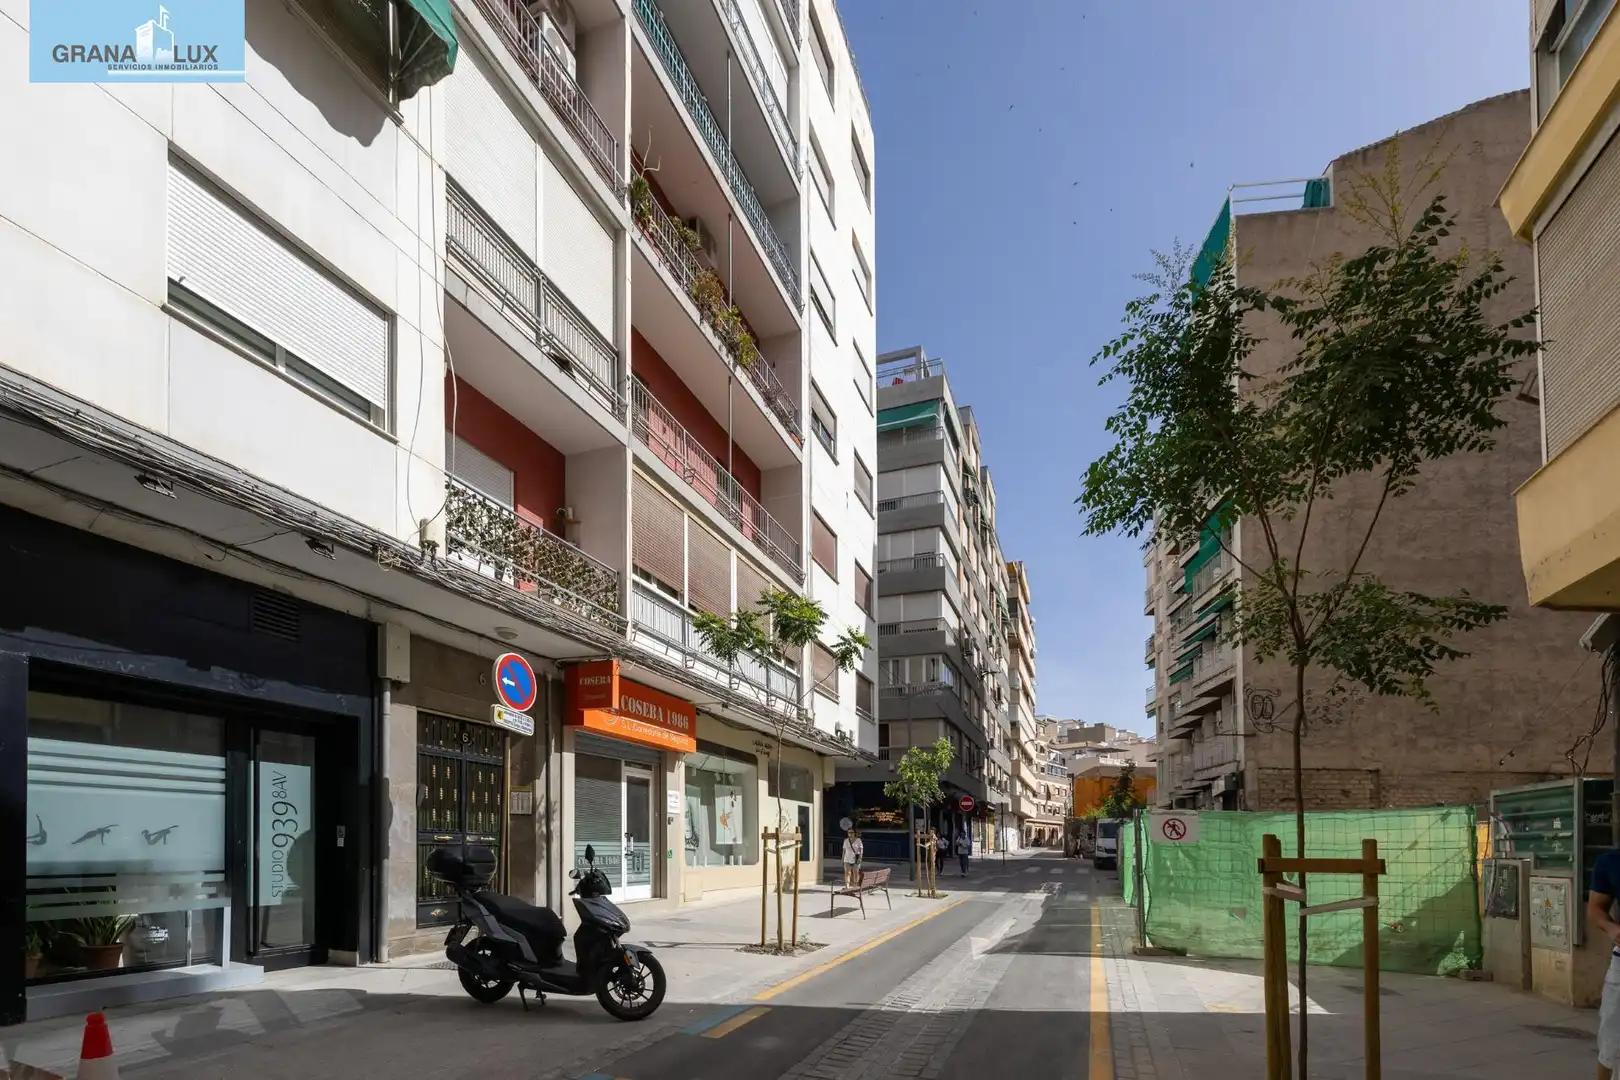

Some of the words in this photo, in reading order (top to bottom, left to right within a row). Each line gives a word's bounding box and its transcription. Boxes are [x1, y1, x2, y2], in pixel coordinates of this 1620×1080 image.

[479, 673, 487, 685] 6
[579, 674, 611, 686] COSEBA
[620, 694, 665, 723] COSEBA
[666, 709, 690, 730] 1986
[462, 732, 469, 743] 6
[271, 801, 299, 848] 939
[271, 849, 284, 898] STUDIO
